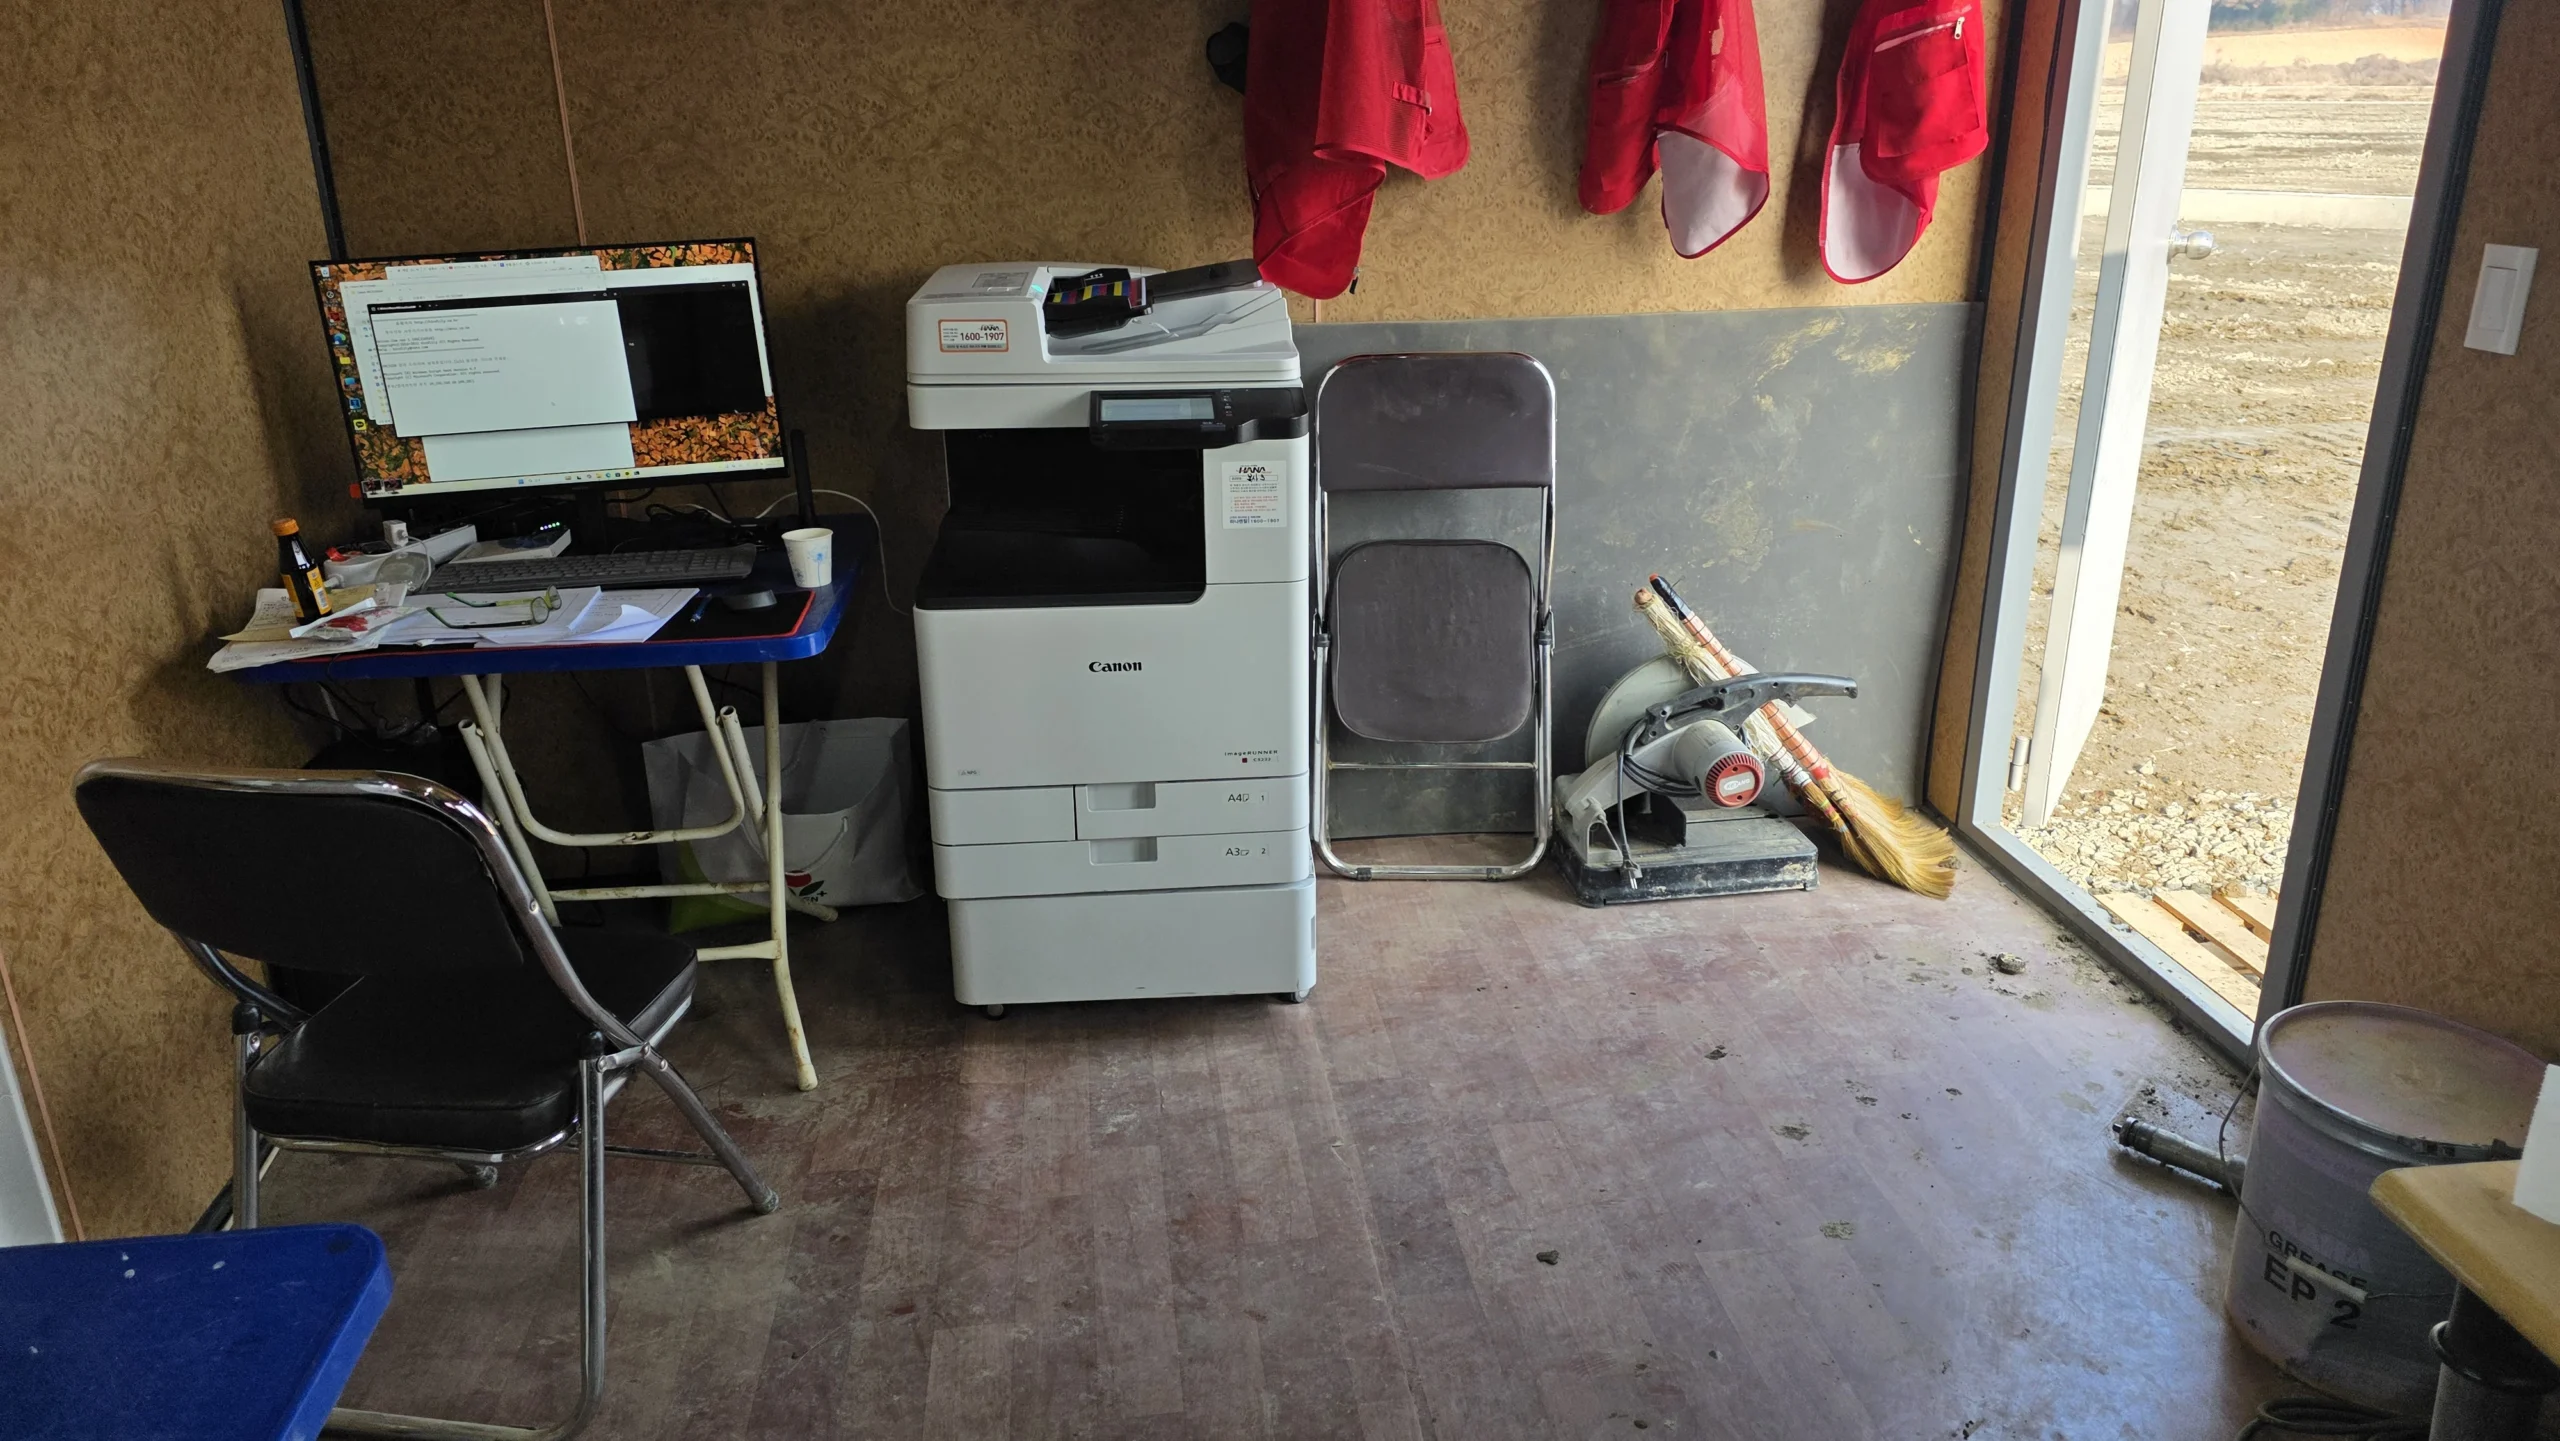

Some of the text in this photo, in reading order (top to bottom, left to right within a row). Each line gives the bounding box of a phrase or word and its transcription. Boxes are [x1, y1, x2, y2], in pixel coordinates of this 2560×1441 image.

[960, 332, 1005, 341] 1600-1907
[1088, 661, 1143, 673] Canon
[1224, 749, 1279, 757] imageRUNNER
[1227, 793, 1242, 802] A4
[1225, 847, 1267, 857] A3 2
[2263, 1252, 2362, 1330] EP 2
